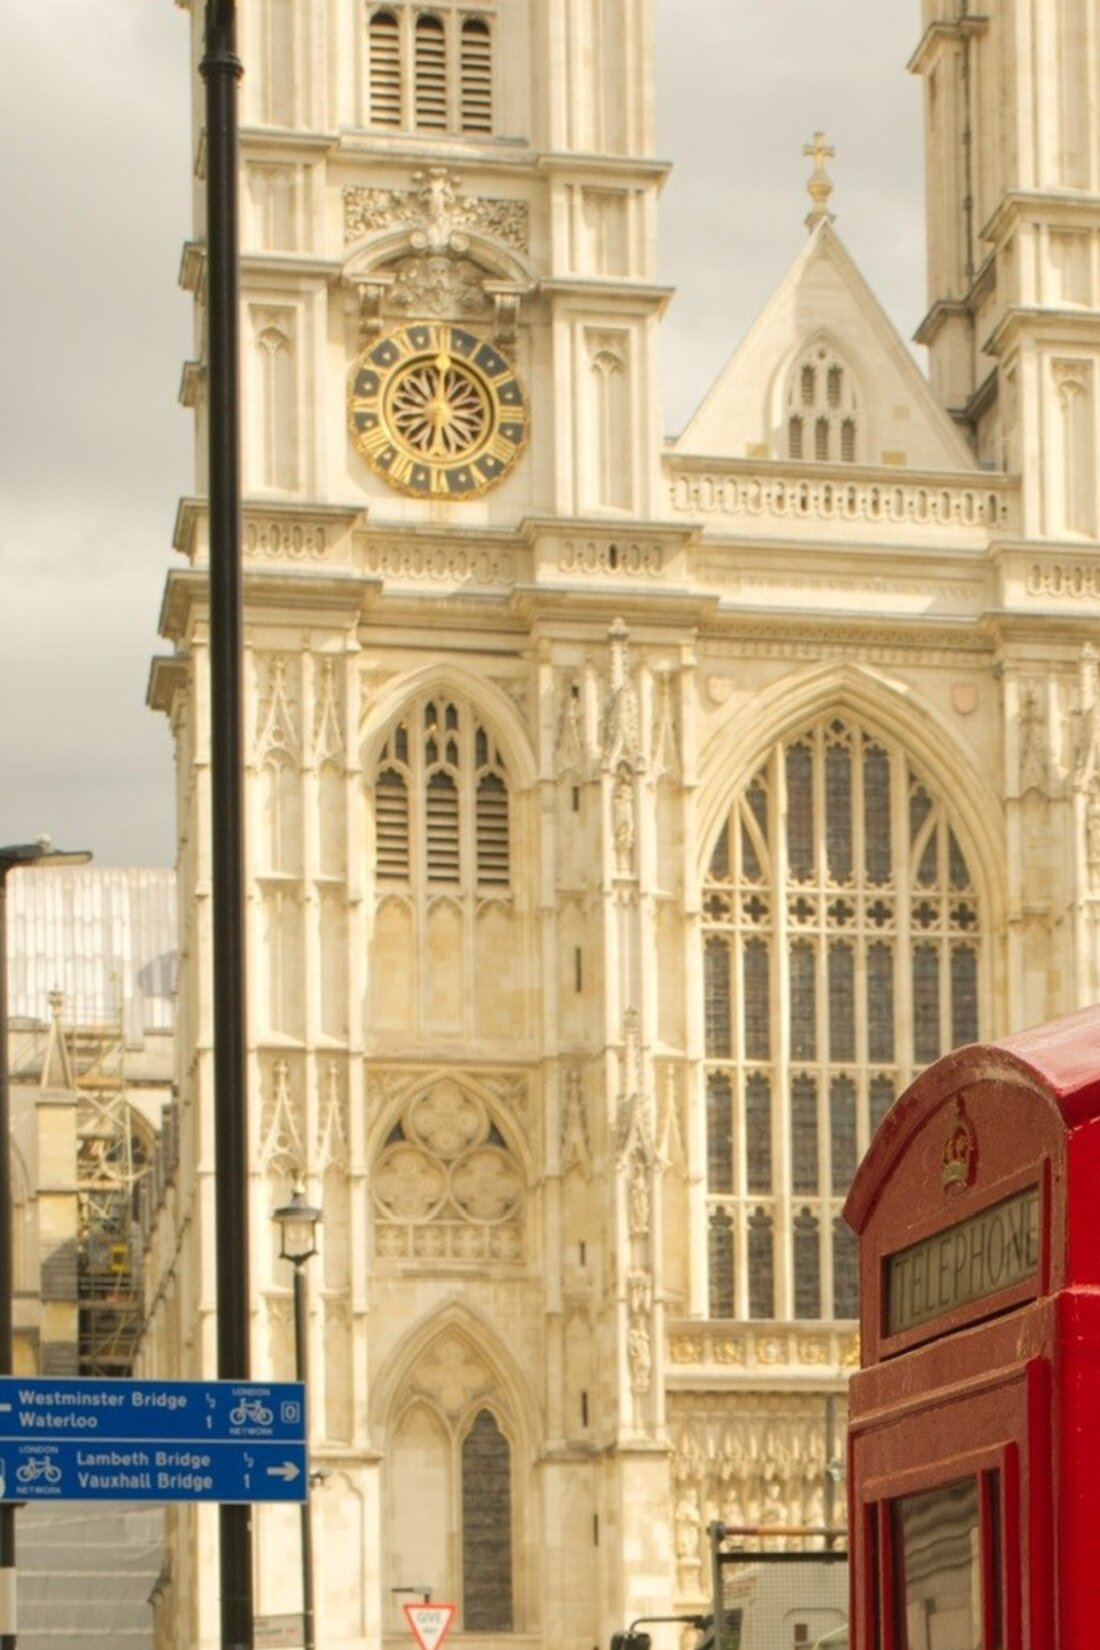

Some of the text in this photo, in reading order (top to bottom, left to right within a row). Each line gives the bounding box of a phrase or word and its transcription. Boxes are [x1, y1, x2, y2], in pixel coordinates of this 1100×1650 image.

[895, 1200, 1038, 1323] TELEPHONE
[19, 1390, 125, 1406] Westminster
[131, 1391, 188, 1410] Bridge
[232, 1388, 270, 1396] LONDON
[19, 1411, 98, 1428] Waterloo
[229, 1427, 273, 1435] NETWORK
[19, 1446, 59, 1454] LONDON
[77, 1451, 149, 1466] Lambeth
[155, 1452, 211, 1469] Bridge
[16, 1486, 61, 1494] NETWORK
[78, 1472, 151, 1489] Vauxhall
[158, 1473, 213, 1492] Bridge
